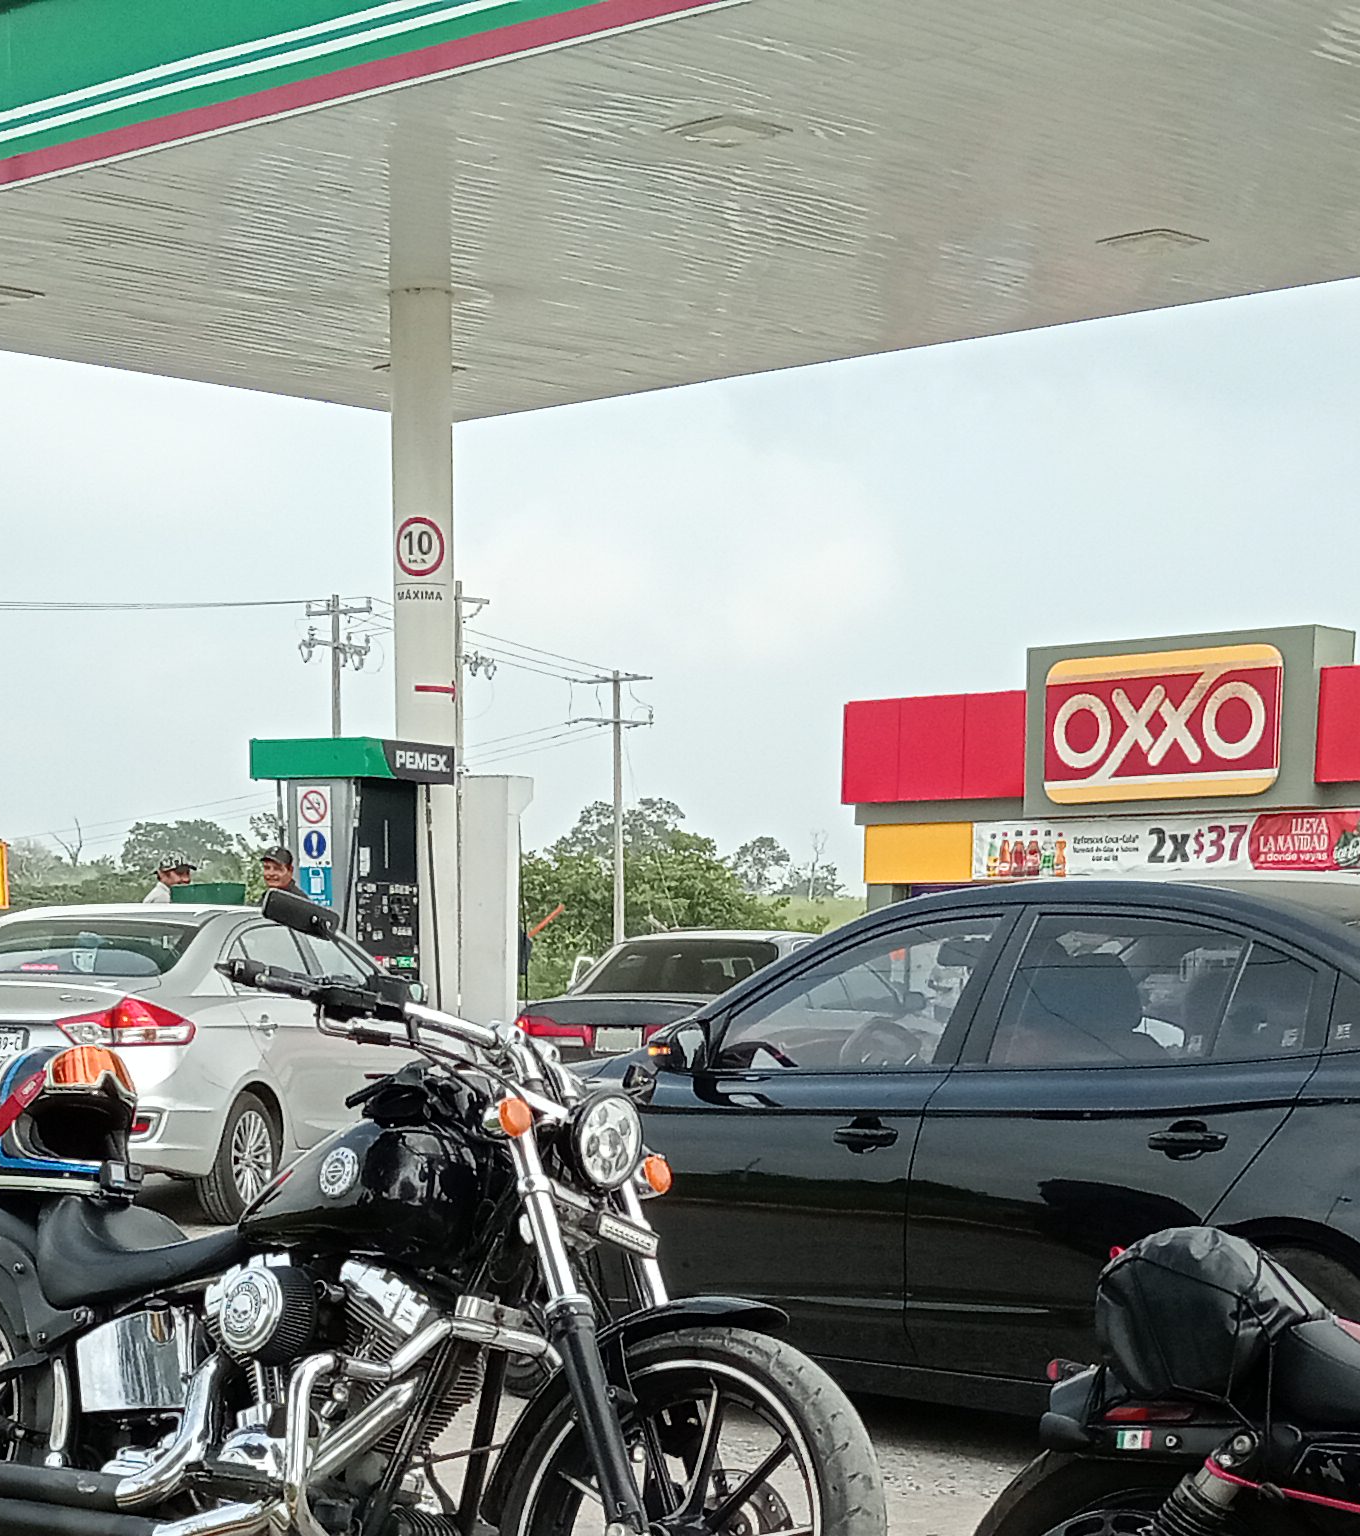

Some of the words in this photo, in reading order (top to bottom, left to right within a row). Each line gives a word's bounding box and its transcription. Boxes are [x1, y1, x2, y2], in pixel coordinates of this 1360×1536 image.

[403, 530, 433, 556] 10
[397, 588, 443, 601] MÁXIMA
[1052, 682, 1267, 770] OXXO
[395, 750, 448, 773] PEMEX
[1291, 817, 1328, 835] LLEVA
[1259, 835, 1275, 852] LA
[1276, 835, 1328, 852] NAVIDAD
[1267, 852, 1297, 862] donde
[1299, 853, 1328, 863] vayas
